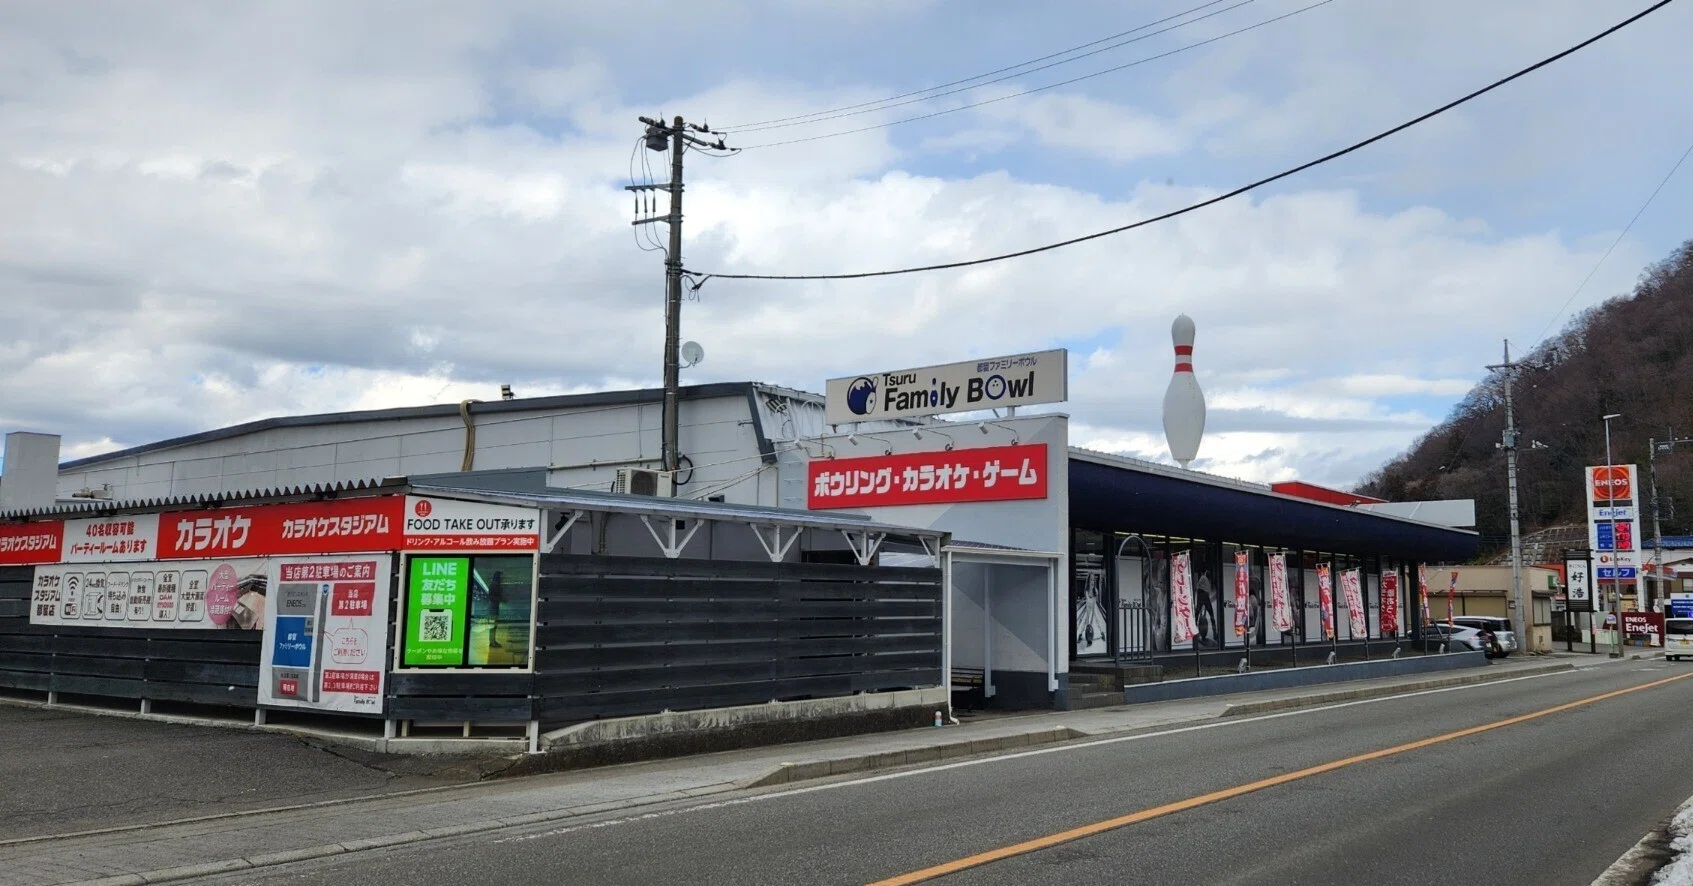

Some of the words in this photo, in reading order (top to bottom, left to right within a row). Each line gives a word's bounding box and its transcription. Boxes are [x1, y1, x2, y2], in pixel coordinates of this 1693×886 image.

[882, 373, 917, 386] Tsuru
[884, 378, 960, 412] Family
[814, 458, 1038, 497] ボウリング・カラオケ・ゲーム
[86, 521, 135, 537] 40名収容可能
[282, 514, 389, 539] カラオケスタジアム
[407, 519, 440, 531] FOOD
[444, 518, 473, 530] TAKE
[175, 515, 251, 551] カラオケ
[0, 533, 57, 552] ラオケスタジアム
[70, 539, 147, 555] パーティールームあります
[285, 564, 371, 580] 当店第2駐車場のご案内
[422, 562, 457, 576] LINE
[37, 575, 61, 587] カラオケ
[421, 578, 457, 591] 友だち
[34, 590, 61, 602] スタジアム
[420, 593, 456, 606] 募集中
